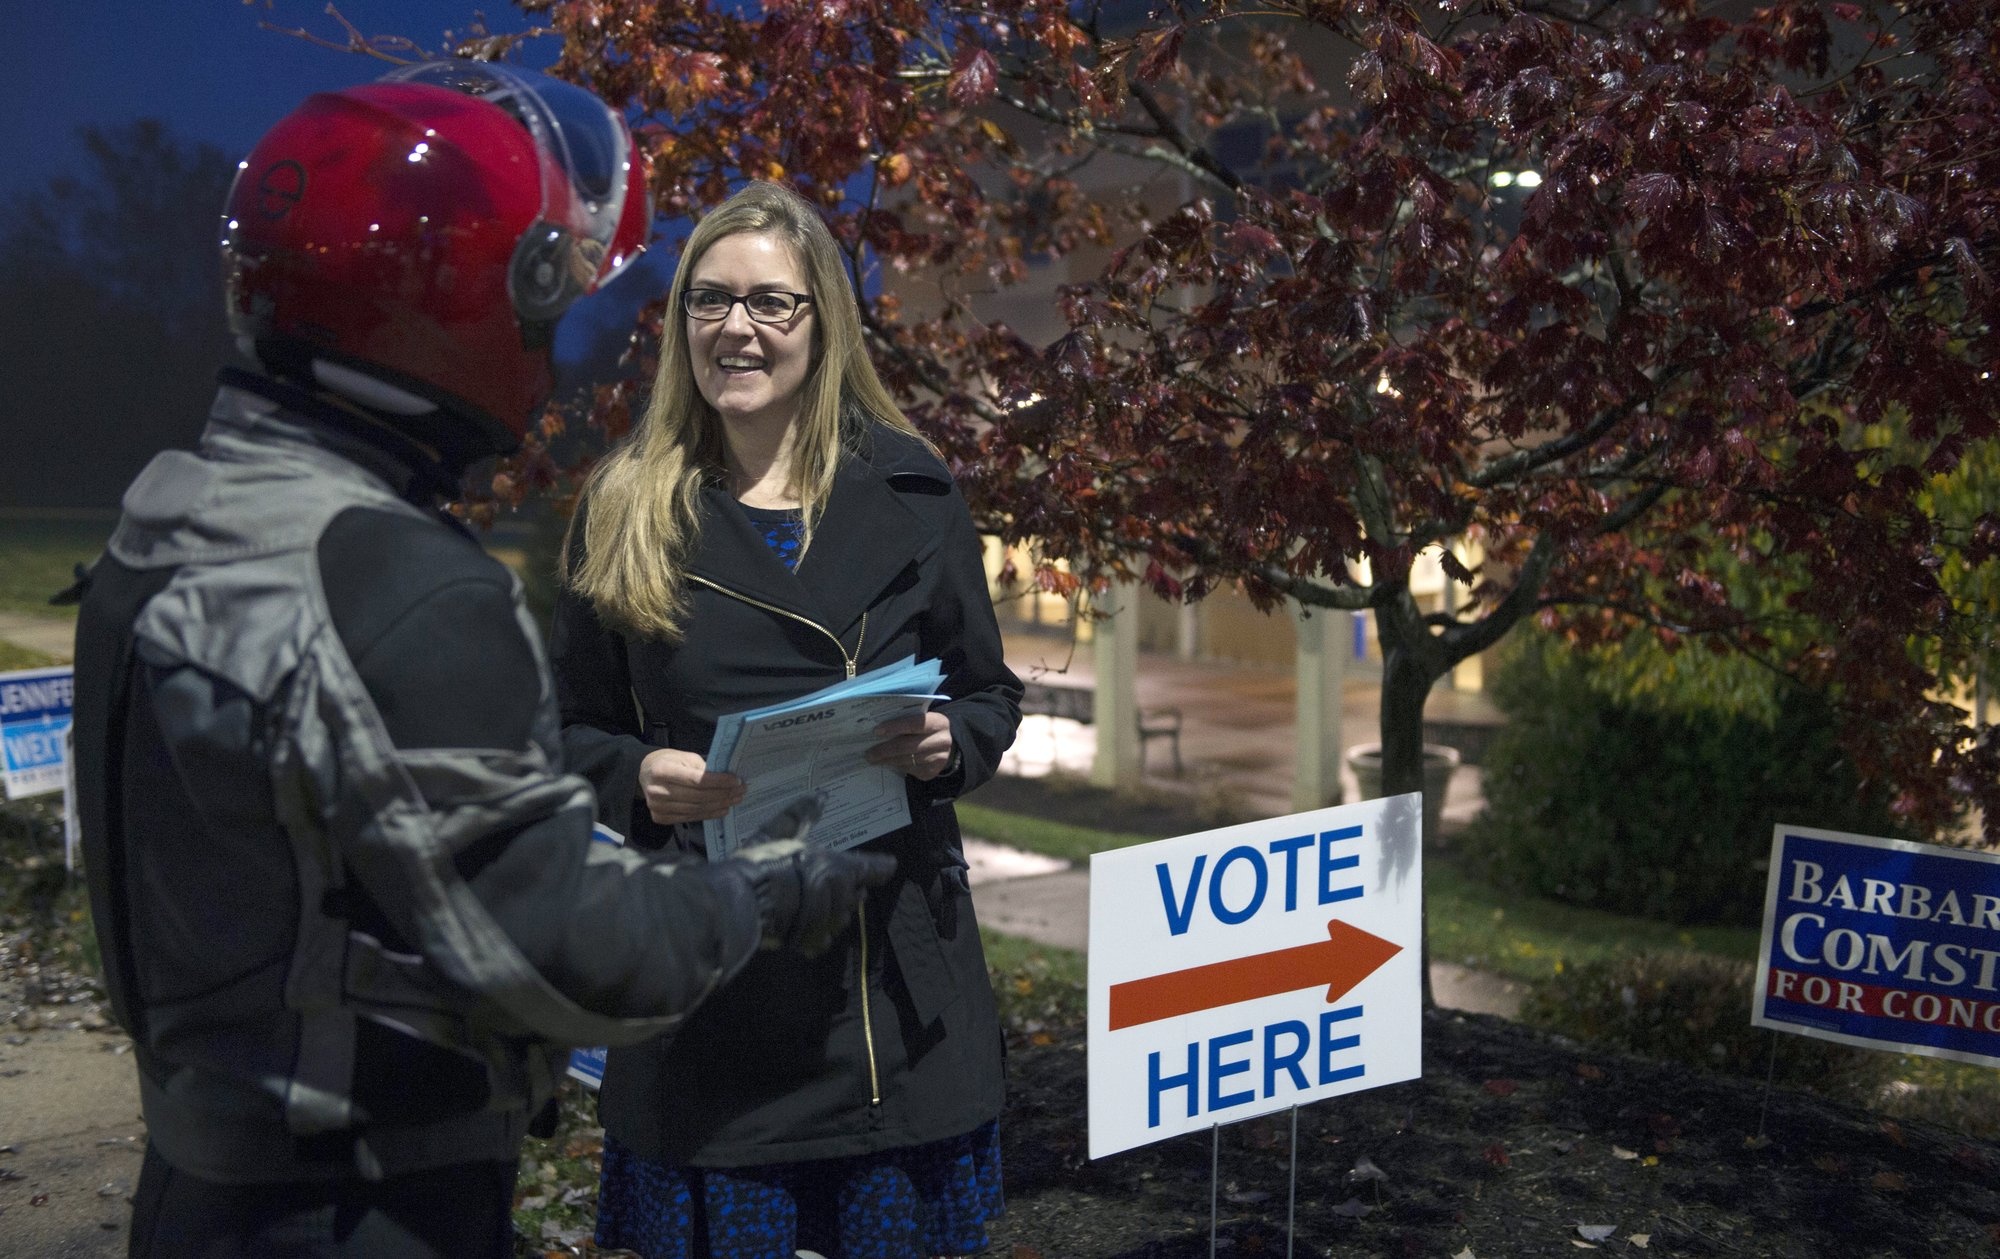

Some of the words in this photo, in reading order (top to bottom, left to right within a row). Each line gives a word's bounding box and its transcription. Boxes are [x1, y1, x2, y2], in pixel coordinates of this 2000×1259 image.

[1155, 824, 1364, 936] VOTE
[1788, 859, 2000, 931] BARBAR
[1773, 969, 1865, 1013] FOR
[1780, 912, 2000, 992] COMST
[1148, 1005, 1365, 1128] HERE
